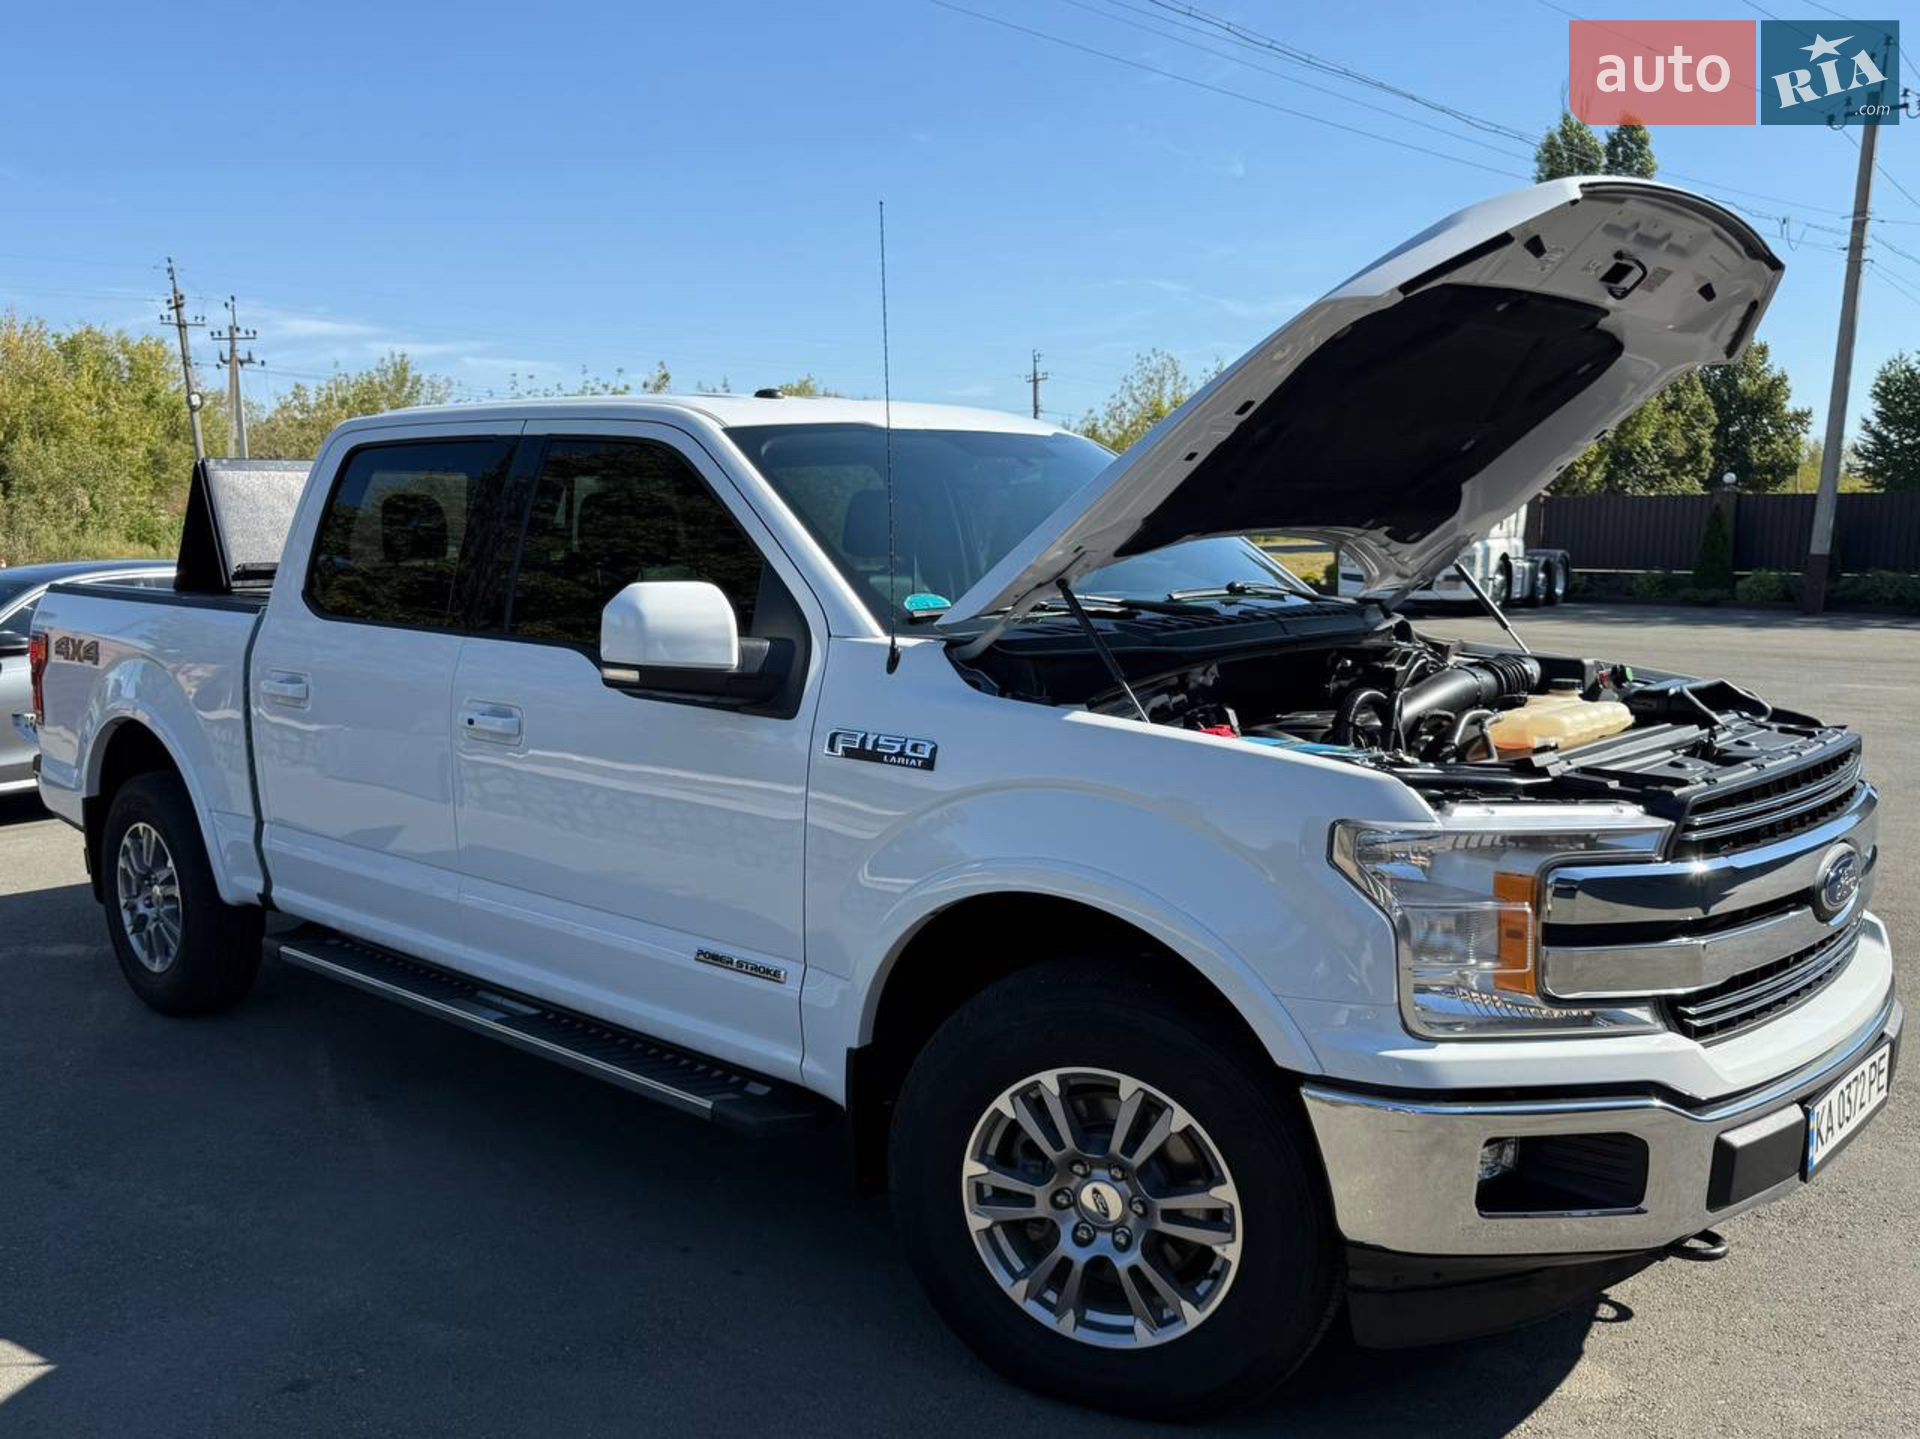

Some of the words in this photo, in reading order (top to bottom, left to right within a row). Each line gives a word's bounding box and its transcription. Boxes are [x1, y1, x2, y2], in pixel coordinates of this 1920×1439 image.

[882, 754, 923, 767] LARIAT
[696, 948, 734, 966] POWER
[735, 959, 782, 979] STROKE
[1815, 1099, 1834, 1153] KA
[1837, 1070, 1866, 1129] 0372
[1868, 1052, 1886, 1103] PE
